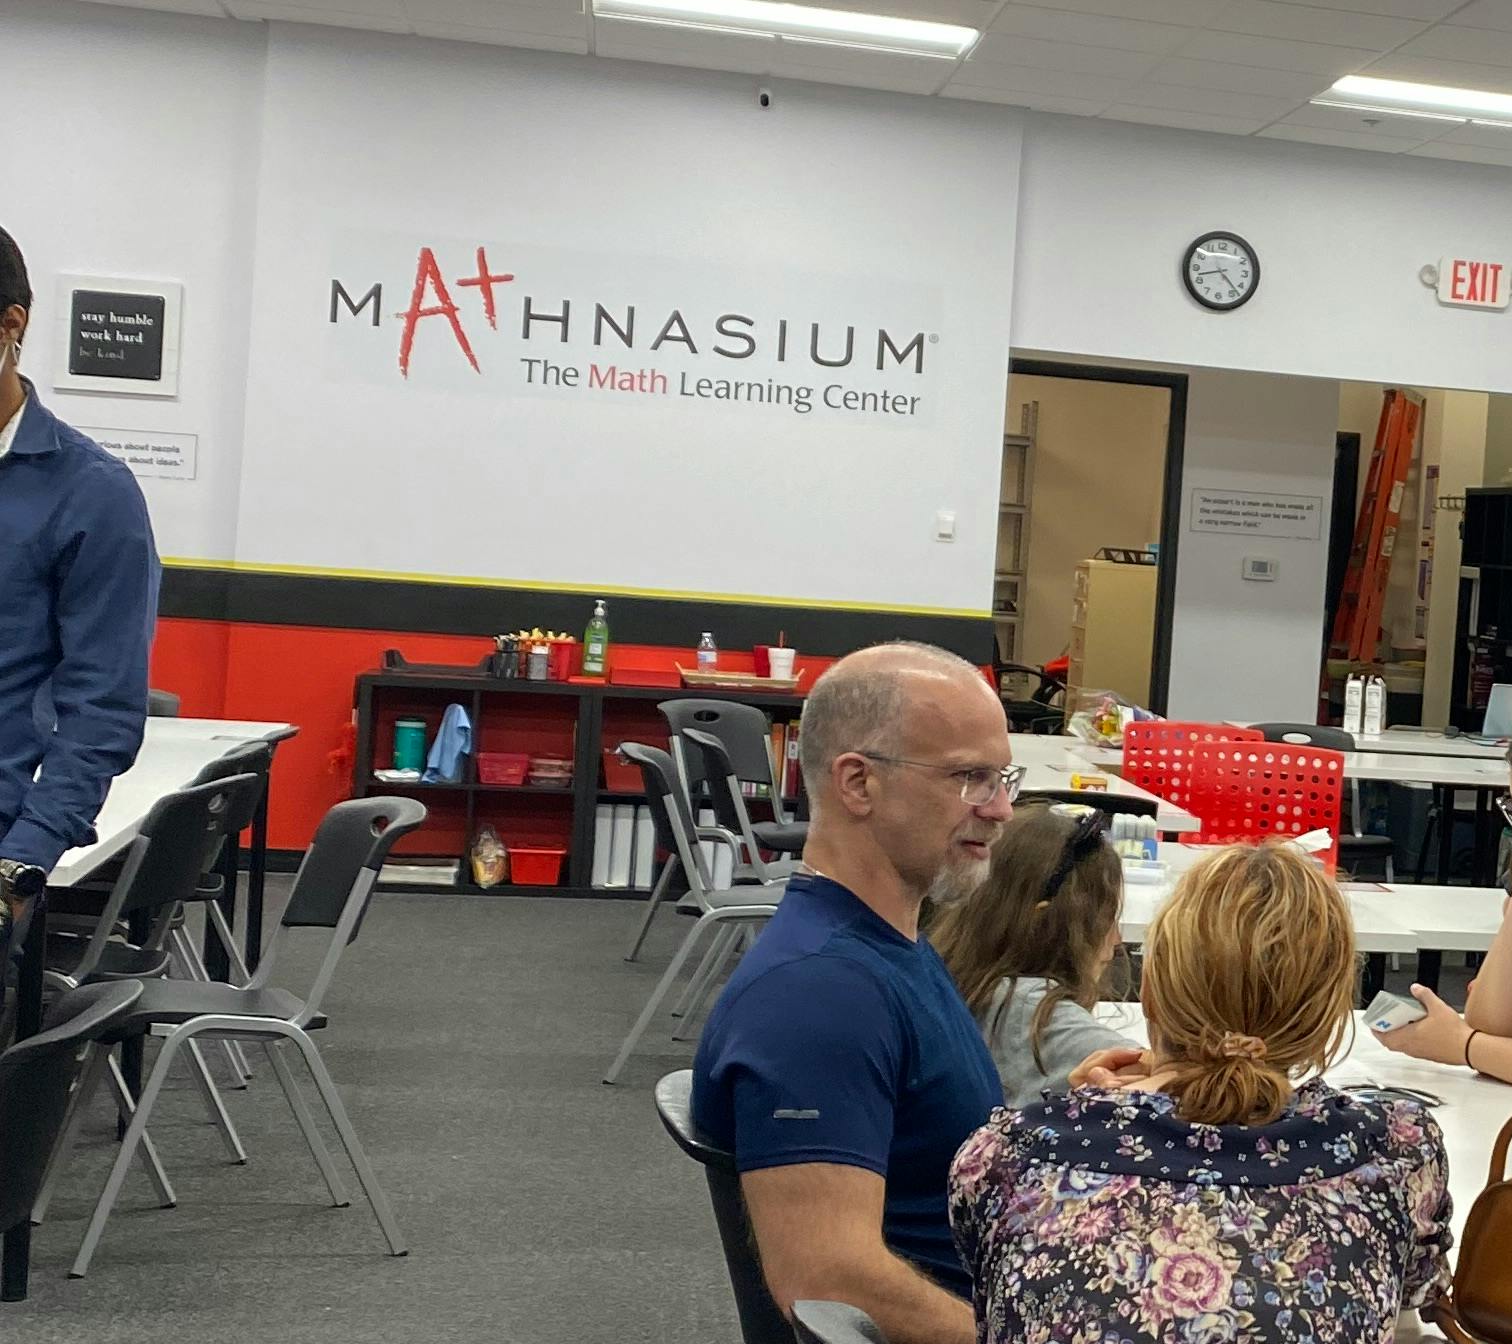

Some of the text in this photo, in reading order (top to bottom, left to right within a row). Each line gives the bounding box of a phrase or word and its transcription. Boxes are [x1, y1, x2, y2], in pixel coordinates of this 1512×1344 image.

[1218, 242, 1228, 251] 12
[1240, 257, 1248, 266] 2
[1192, 264, 1200, 272] 9
[1241, 270, 1249, 278] 3
[1196, 276, 1204, 284] 8
[1451, 260, 1504, 302] EXIT
[1214, 292, 1222, 300] 6
[80, 312, 154, 326] stay humble
[80, 330, 144, 344] work hard
[520, 358, 920, 416] The Math Learning Center
